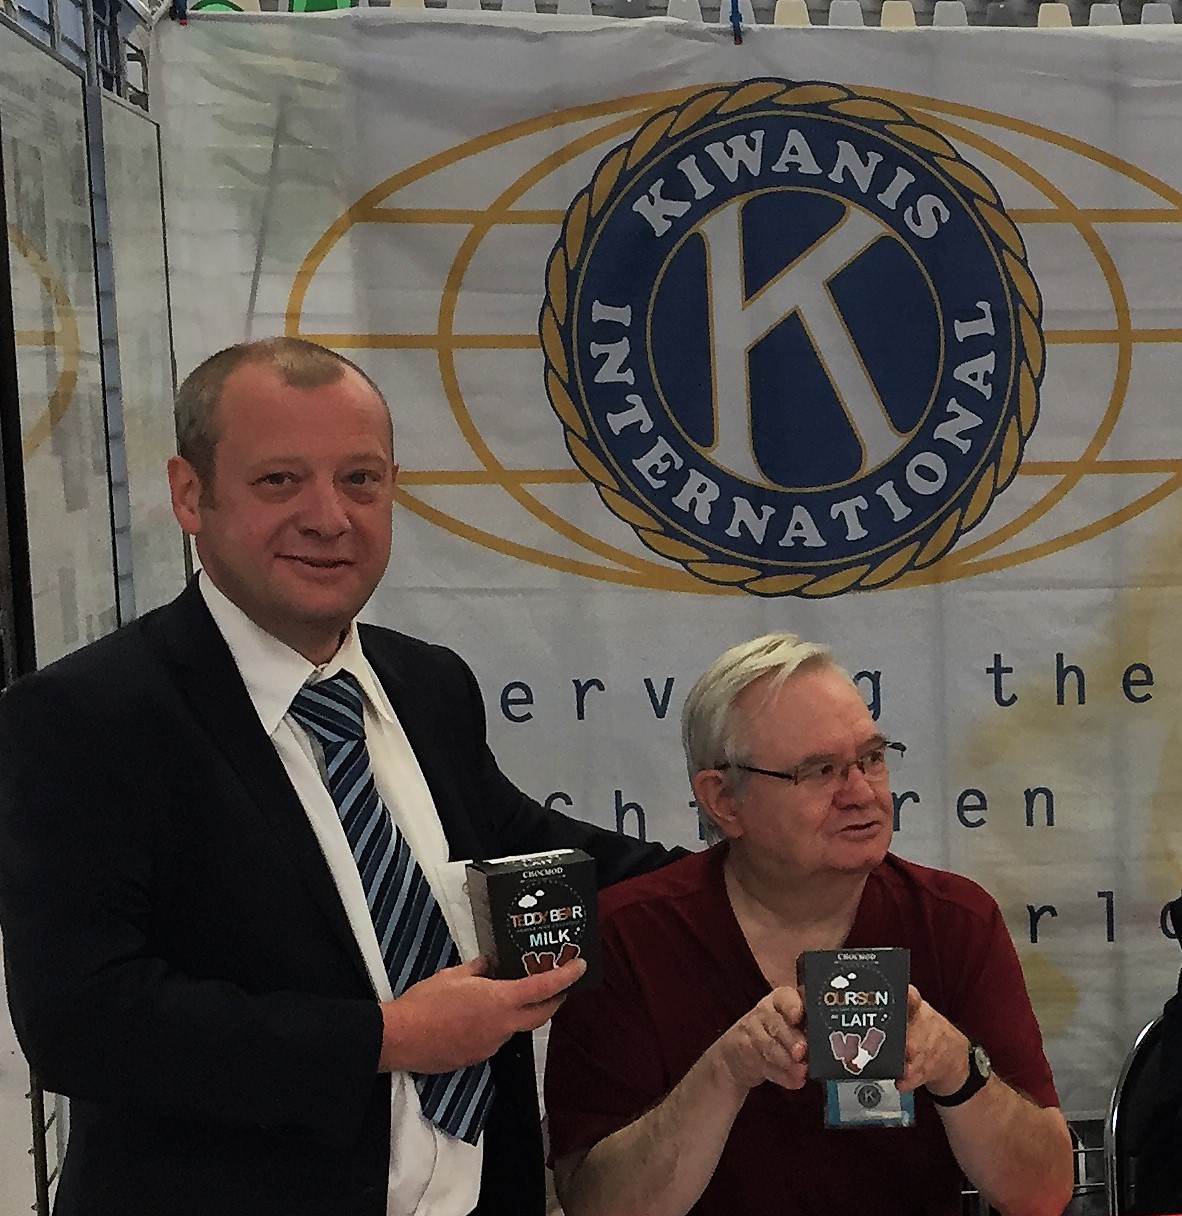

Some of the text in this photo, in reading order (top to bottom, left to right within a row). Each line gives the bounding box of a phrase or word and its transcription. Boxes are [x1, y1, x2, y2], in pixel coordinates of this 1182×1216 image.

[631, 128, 951, 239] KIWANIS
[690, 200, 912, 486] K
[590, 298, 996, 548] INTERNATIONAL
[986, 652, 1155, 706] the
[510, 910, 549, 928] TEDDY
[550, 905, 583, 922] BEAR
[529, 929, 571, 948] MILK
[823, 991, 889, 1006] OURSON
[841, 1013, 877, 1027] LAIT
